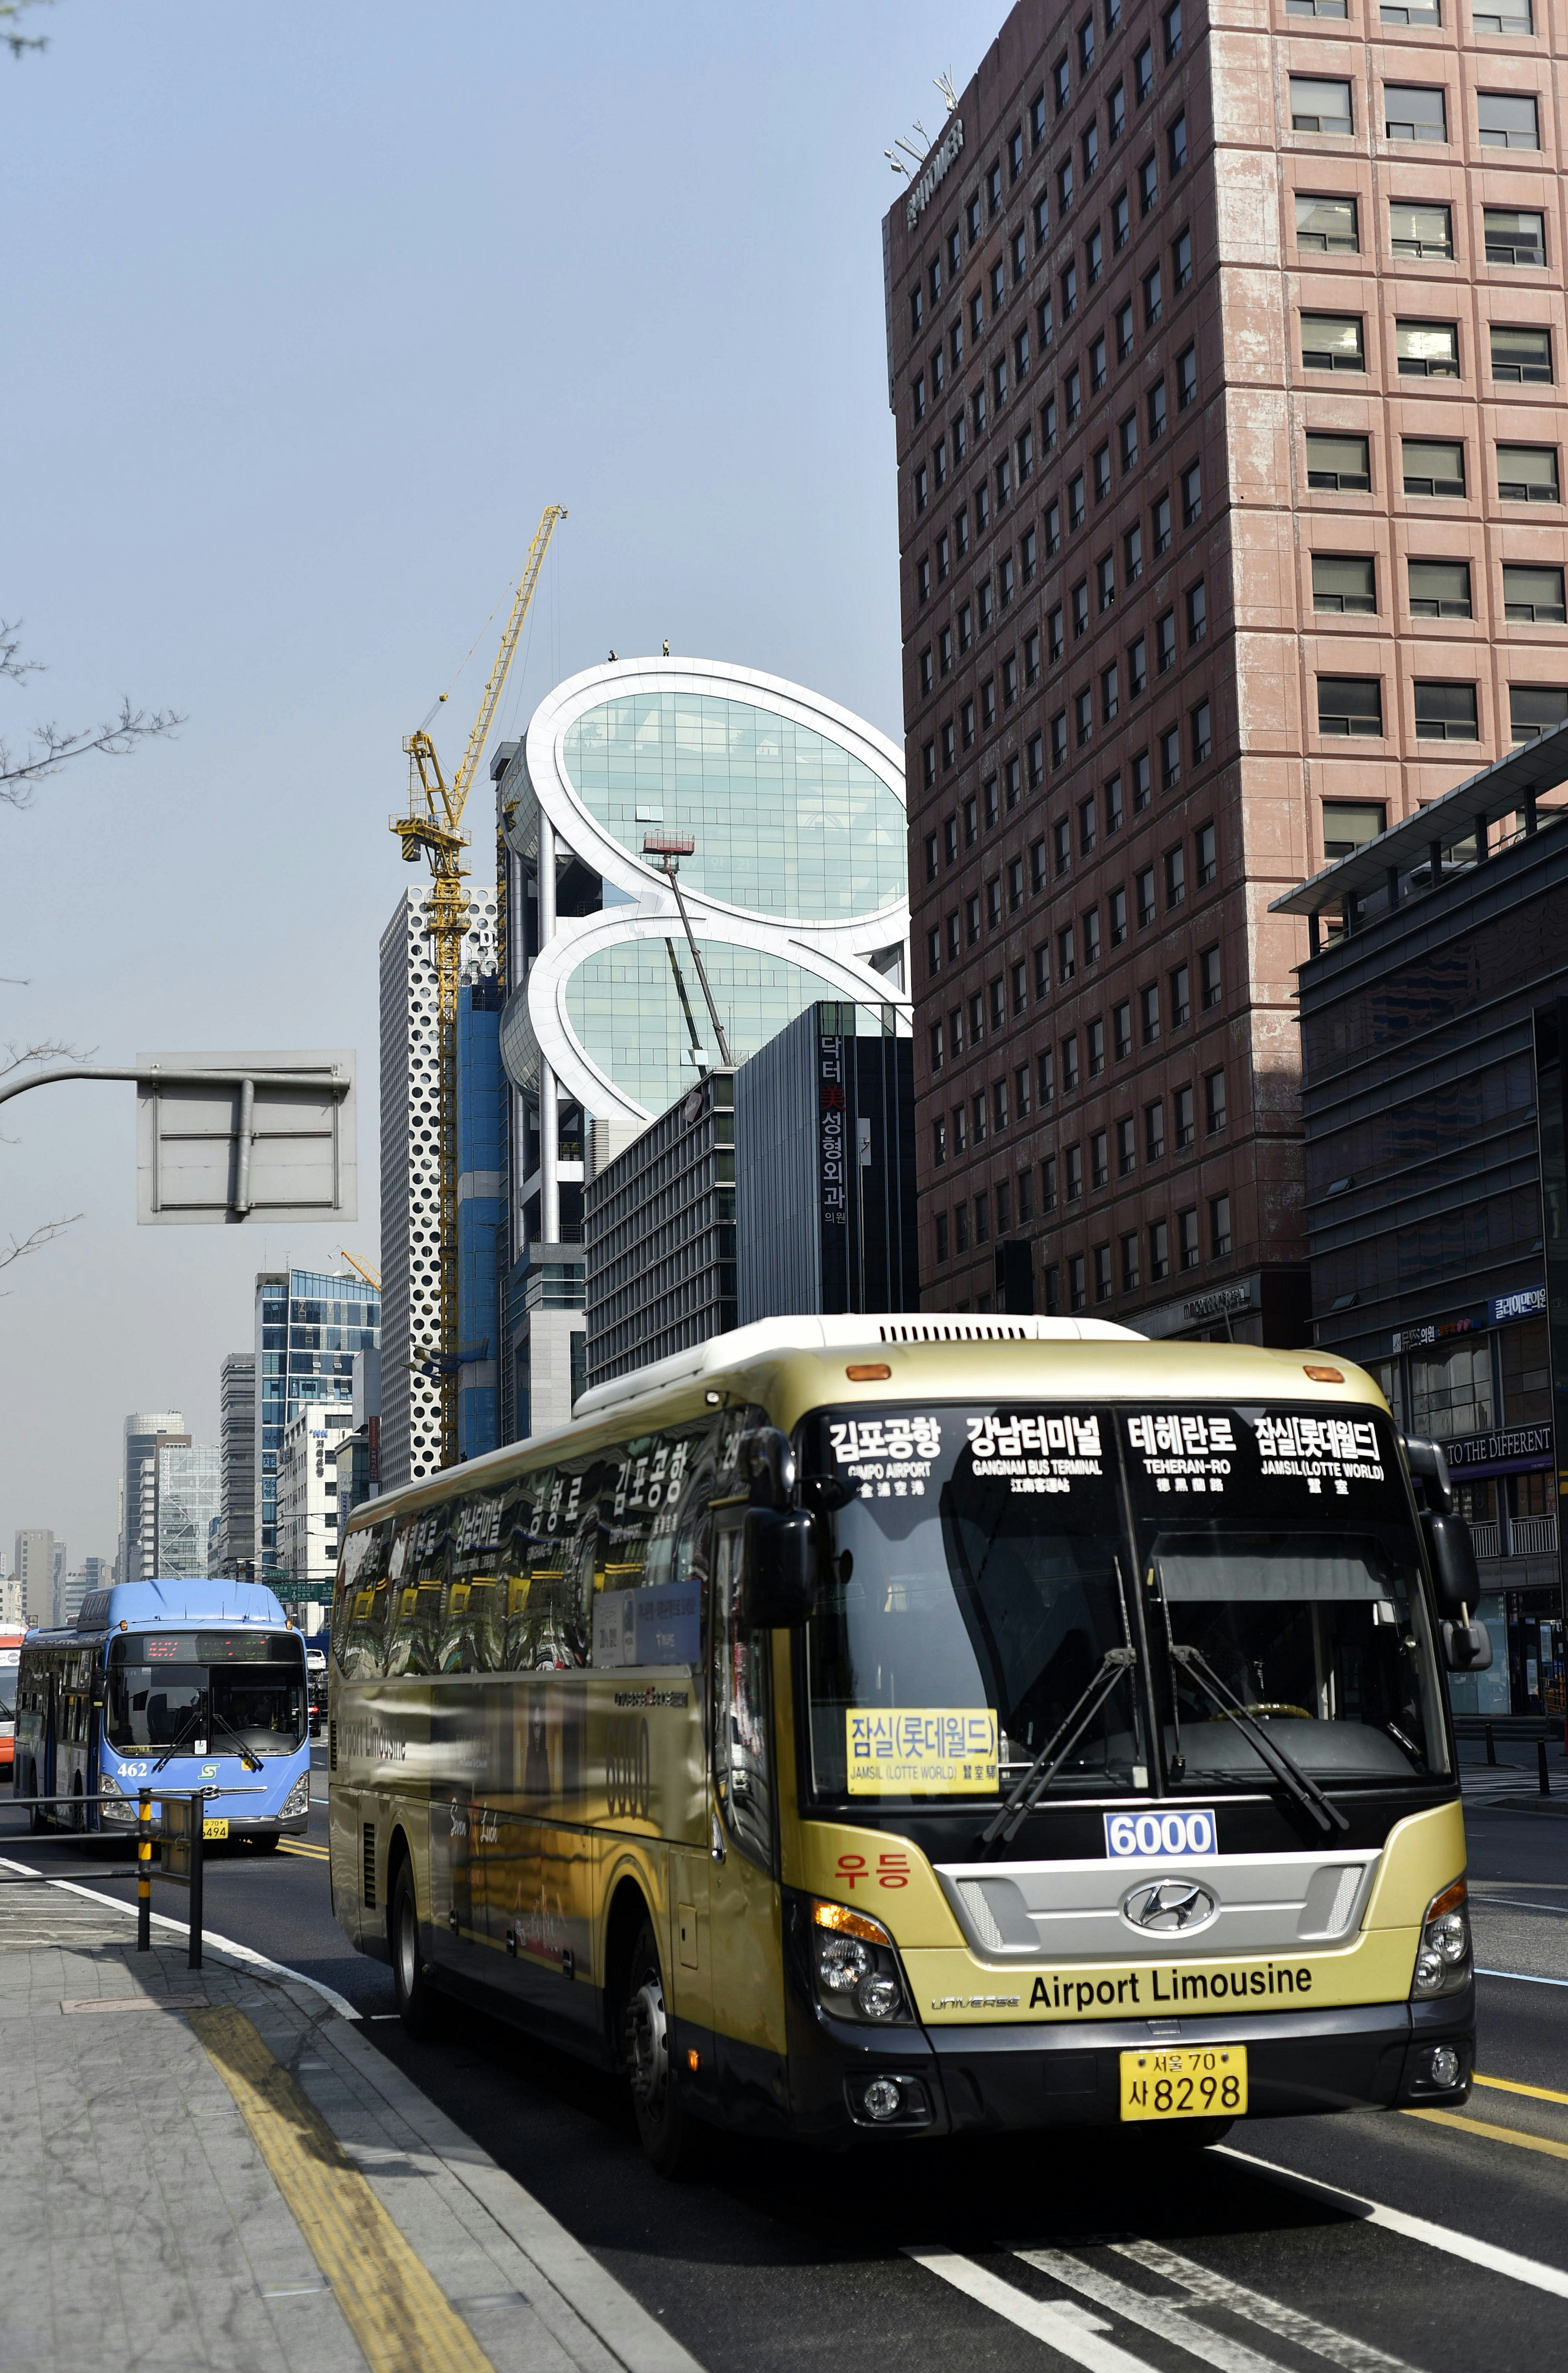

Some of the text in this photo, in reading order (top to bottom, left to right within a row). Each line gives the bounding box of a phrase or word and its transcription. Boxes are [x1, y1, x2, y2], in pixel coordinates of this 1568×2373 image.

[480, 929, 498, 947] D
[1421, 1325, 1435, 1344] 의원
[829, 1416, 942, 1463] 김포공항
[966, 1415, 1102, 1457] 강남터미널
[1127, 1415, 1237, 1455] 테헤란로
[1448, 1428, 1551, 1465] TO THE DIFFERENT
[613, 1441, 688, 1517] 김포공항
[886, 1461, 932, 1479] AIRPORT
[972, 1459, 1103, 1476] GANGNAM BUS TERMINAL
[1142, 1459, 1231, 1475] TEHERAN-RO
[1342, 1463, 1384, 1481] WORLD)
[365, 1717, 406, 1762] Limousine
[852, 1716, 994, 1759] 잠실(롯데월드)
[117, 1762, 147, 1777] 462
[851, 1766, 882, 1780] JAMSIL
[886, 1765, 918, 1781] (LOTTE
[921, 1766, 957, 1781] WORLD)
[450, 1797, 498, 1844] Seven Luck
[1109, 1814, 1212, 1855] 6000
[835, 1854, 911, 1890] 우등
[1029, 1962, 1312, 2012] Airport Limousine
[1152, 2051, 1216, 2073] 서울 70
